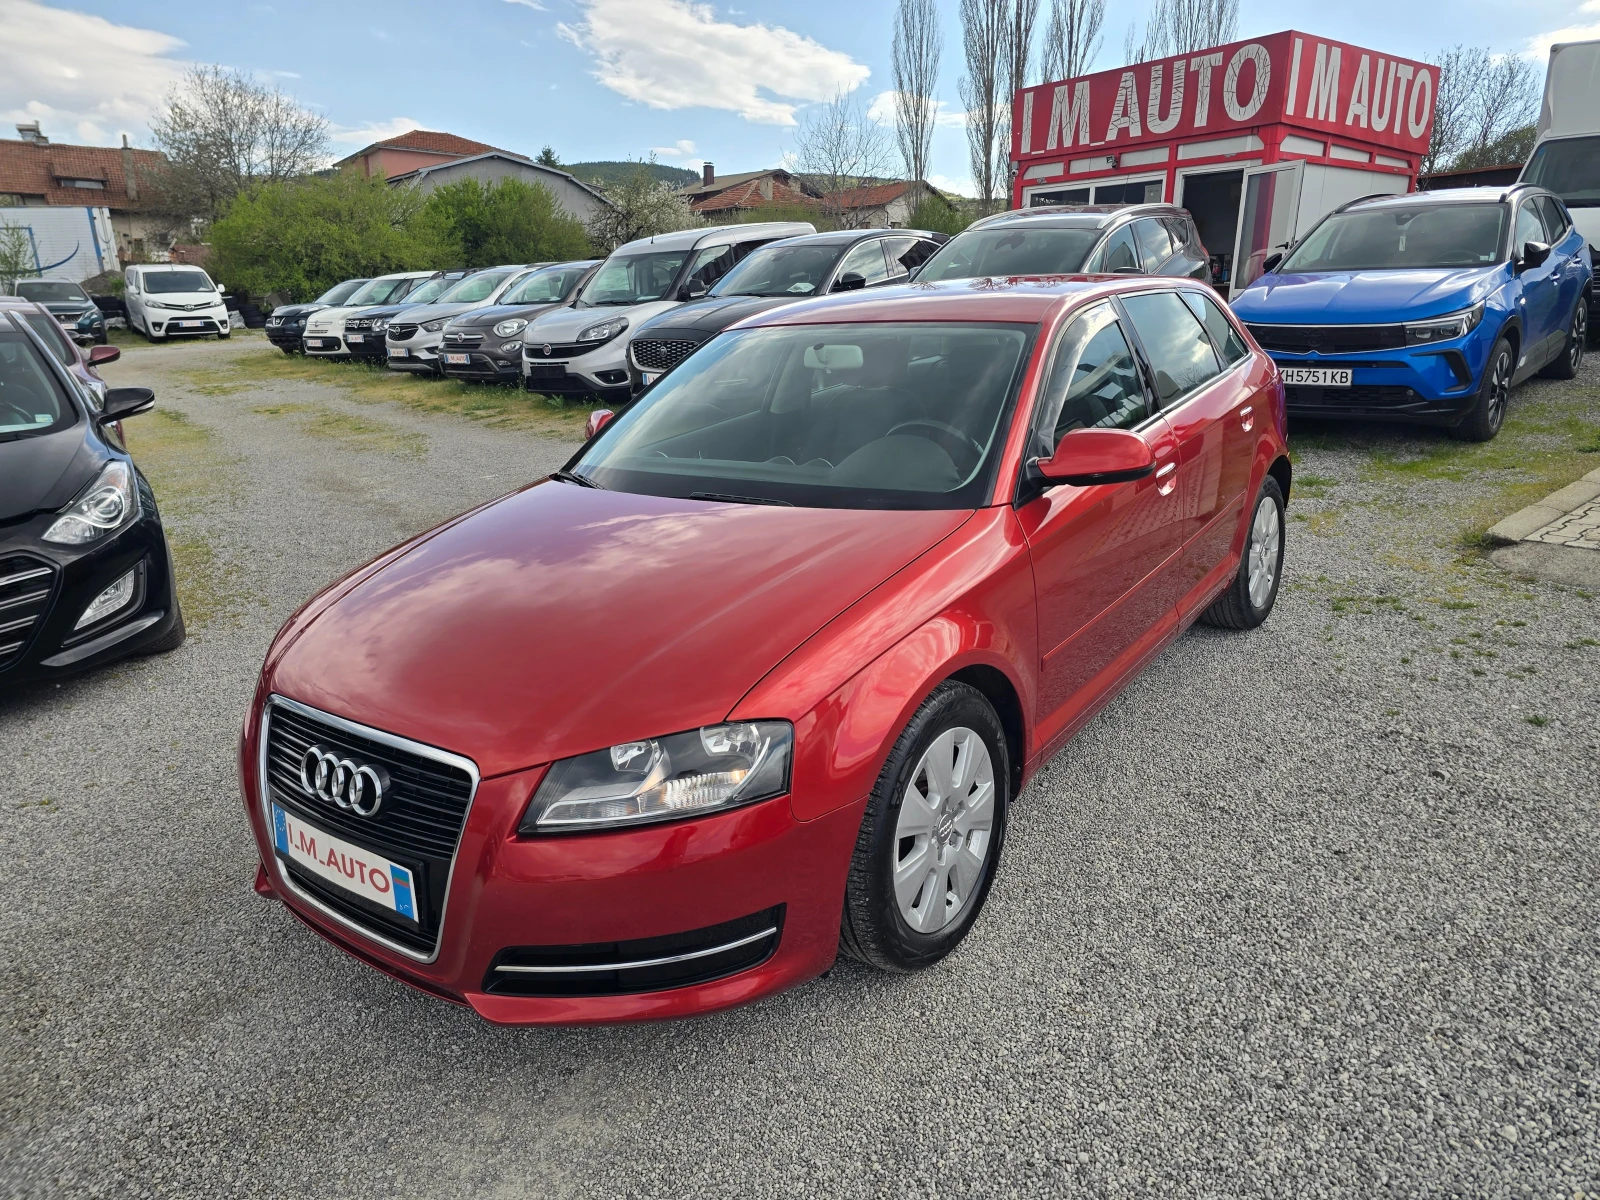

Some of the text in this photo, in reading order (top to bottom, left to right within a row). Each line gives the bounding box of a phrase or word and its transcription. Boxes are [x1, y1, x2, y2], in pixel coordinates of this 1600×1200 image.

[1285, 37, 1432, 139] I M AUTO
